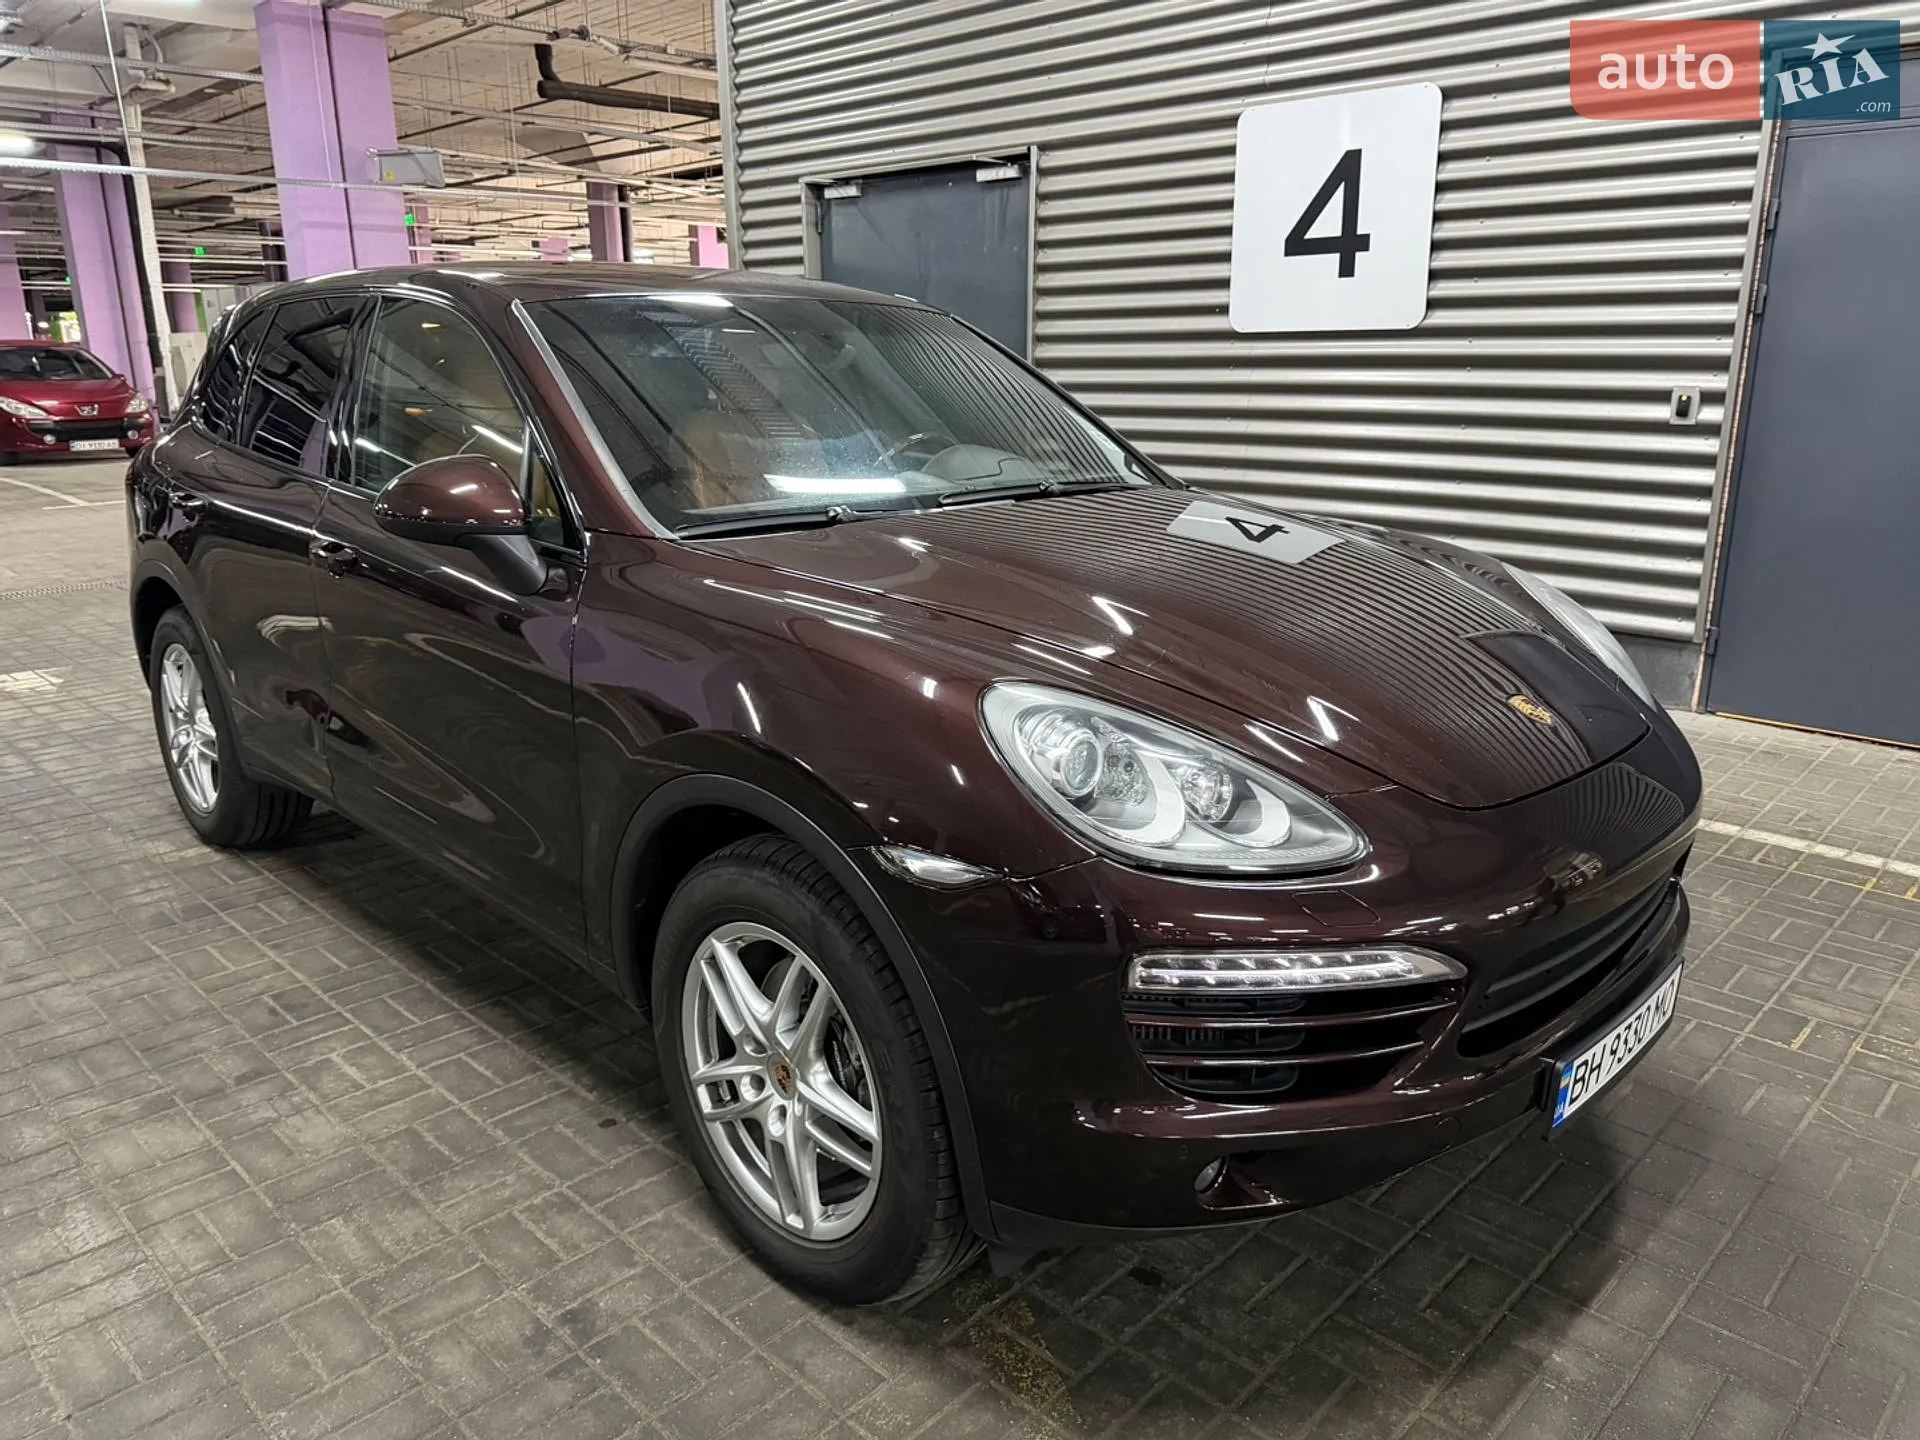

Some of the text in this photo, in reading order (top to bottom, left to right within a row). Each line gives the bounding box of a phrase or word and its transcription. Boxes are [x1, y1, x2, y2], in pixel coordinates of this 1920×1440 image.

[1284, 148, 1371, 278] 4
[1569, 1043, 1606, 1106] BH
[1605, 1004, 1651, 1076] 9330
